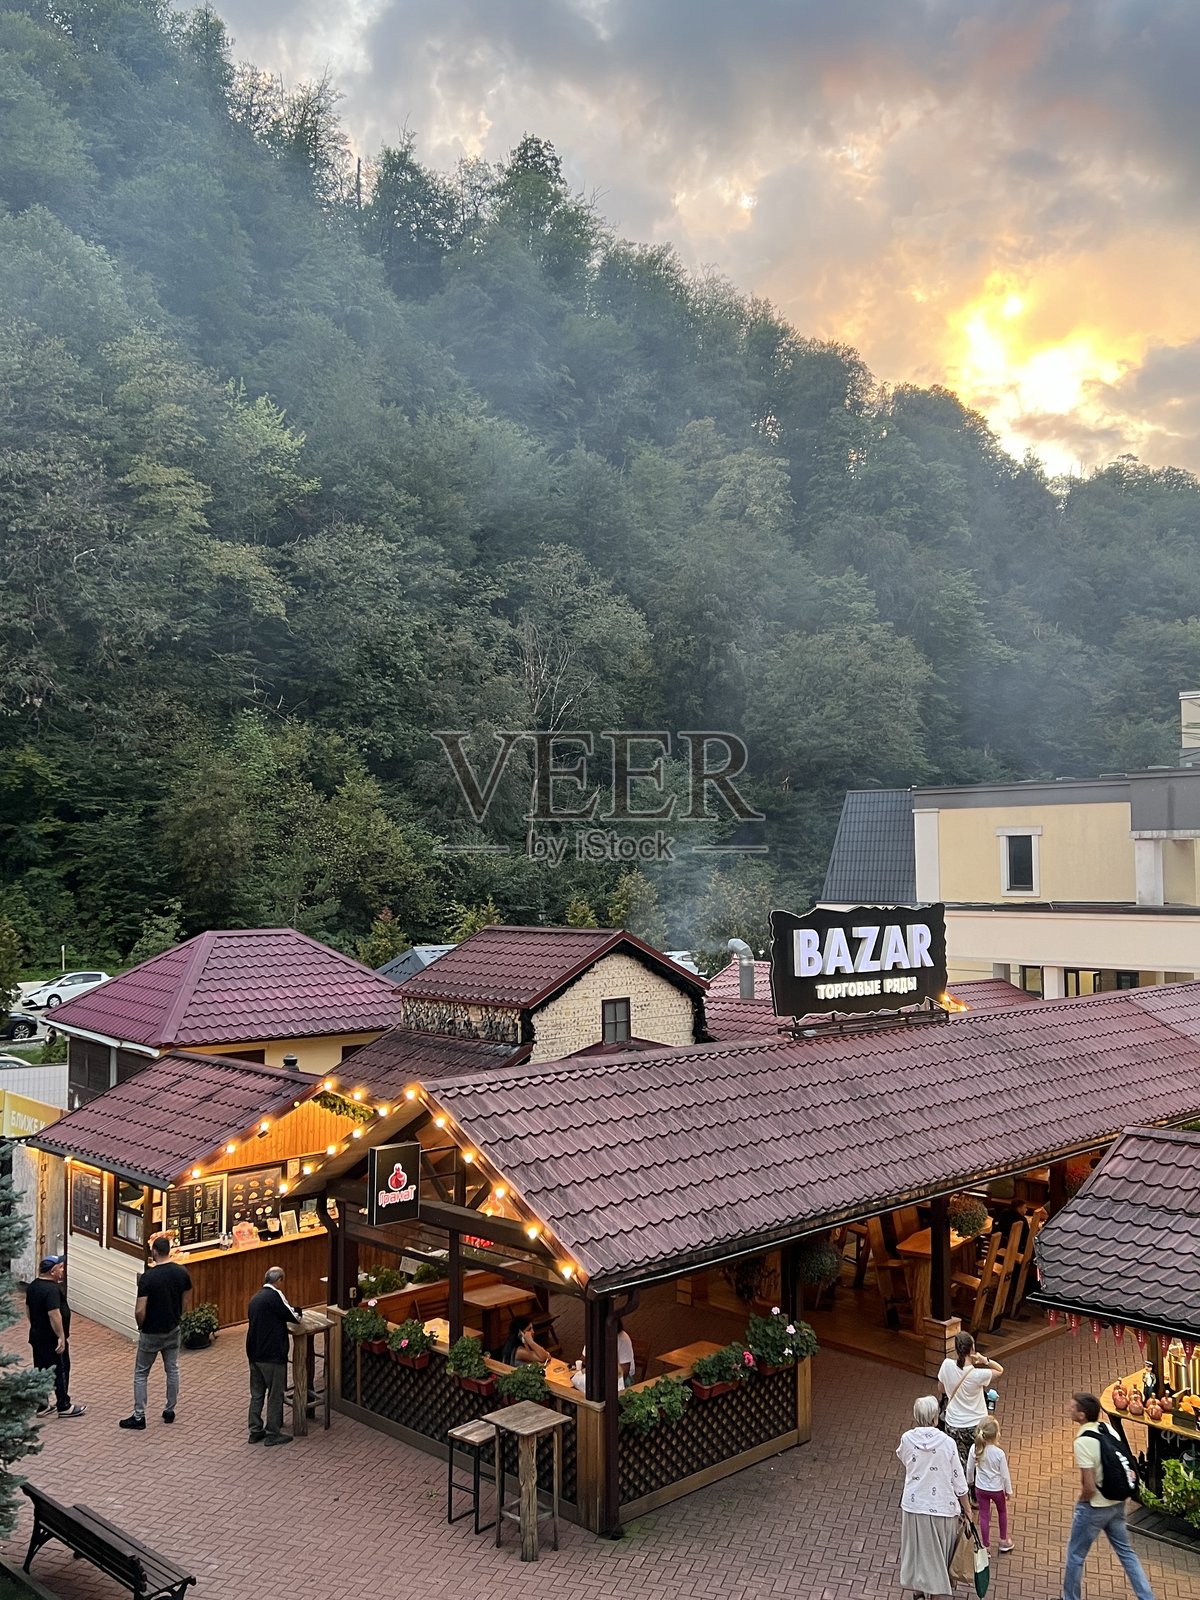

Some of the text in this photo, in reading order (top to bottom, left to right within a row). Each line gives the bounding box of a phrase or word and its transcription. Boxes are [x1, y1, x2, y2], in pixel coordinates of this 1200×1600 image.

[793, 923, 935, 977] BAZAR
[815, 976, 917, 1000] ТОРГОВЫЕ РЯДЫ
